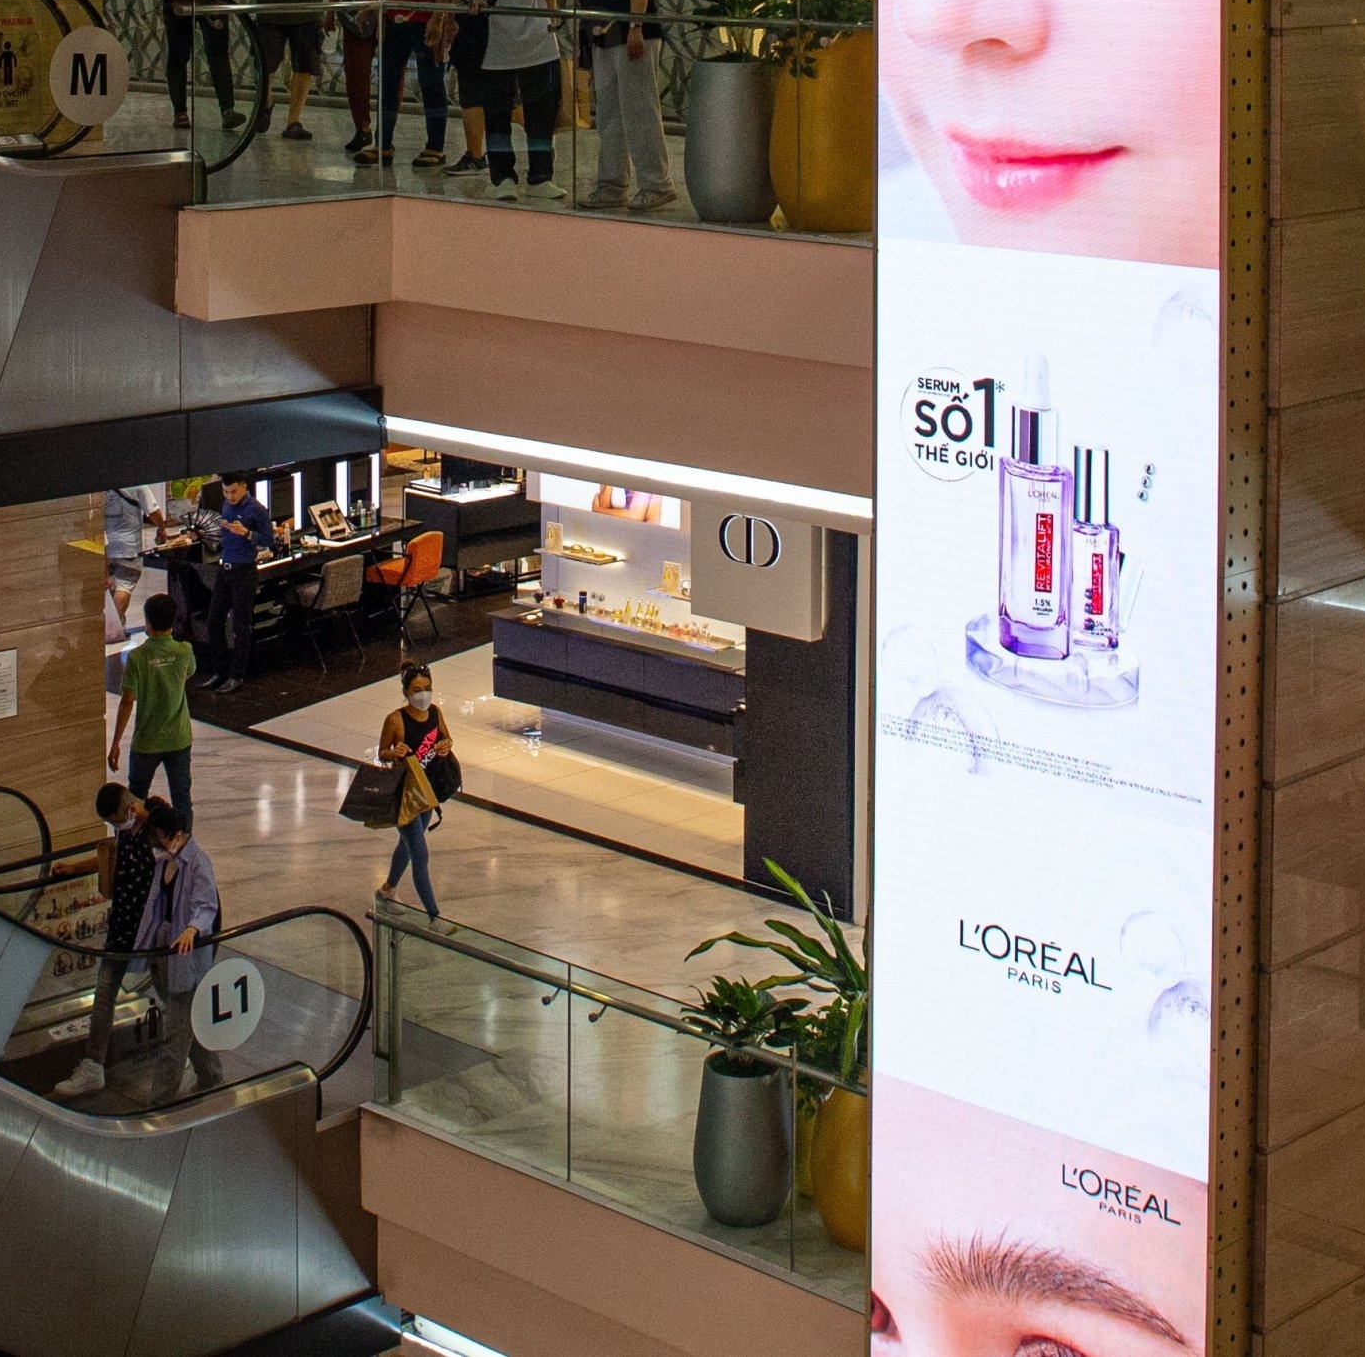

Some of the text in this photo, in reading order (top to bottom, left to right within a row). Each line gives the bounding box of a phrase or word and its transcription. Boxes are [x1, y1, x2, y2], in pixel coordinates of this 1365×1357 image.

[69, 53, 108, 96] M
[917, 377, 961, 394] SERUM
[915, 392, 973, 443] SỐ
[1036, 514, 1047, 591] REVITALIFT
[959, 918, 1113, 992] L'ORÉAL
[1007, 966, 1062, 994] PARIS
[211, 974, 250, 1025] L1
[1061, 1163, 1181, 1226] L'ORÉAL
[1098, 1201, 1143, 1225] PARIS
